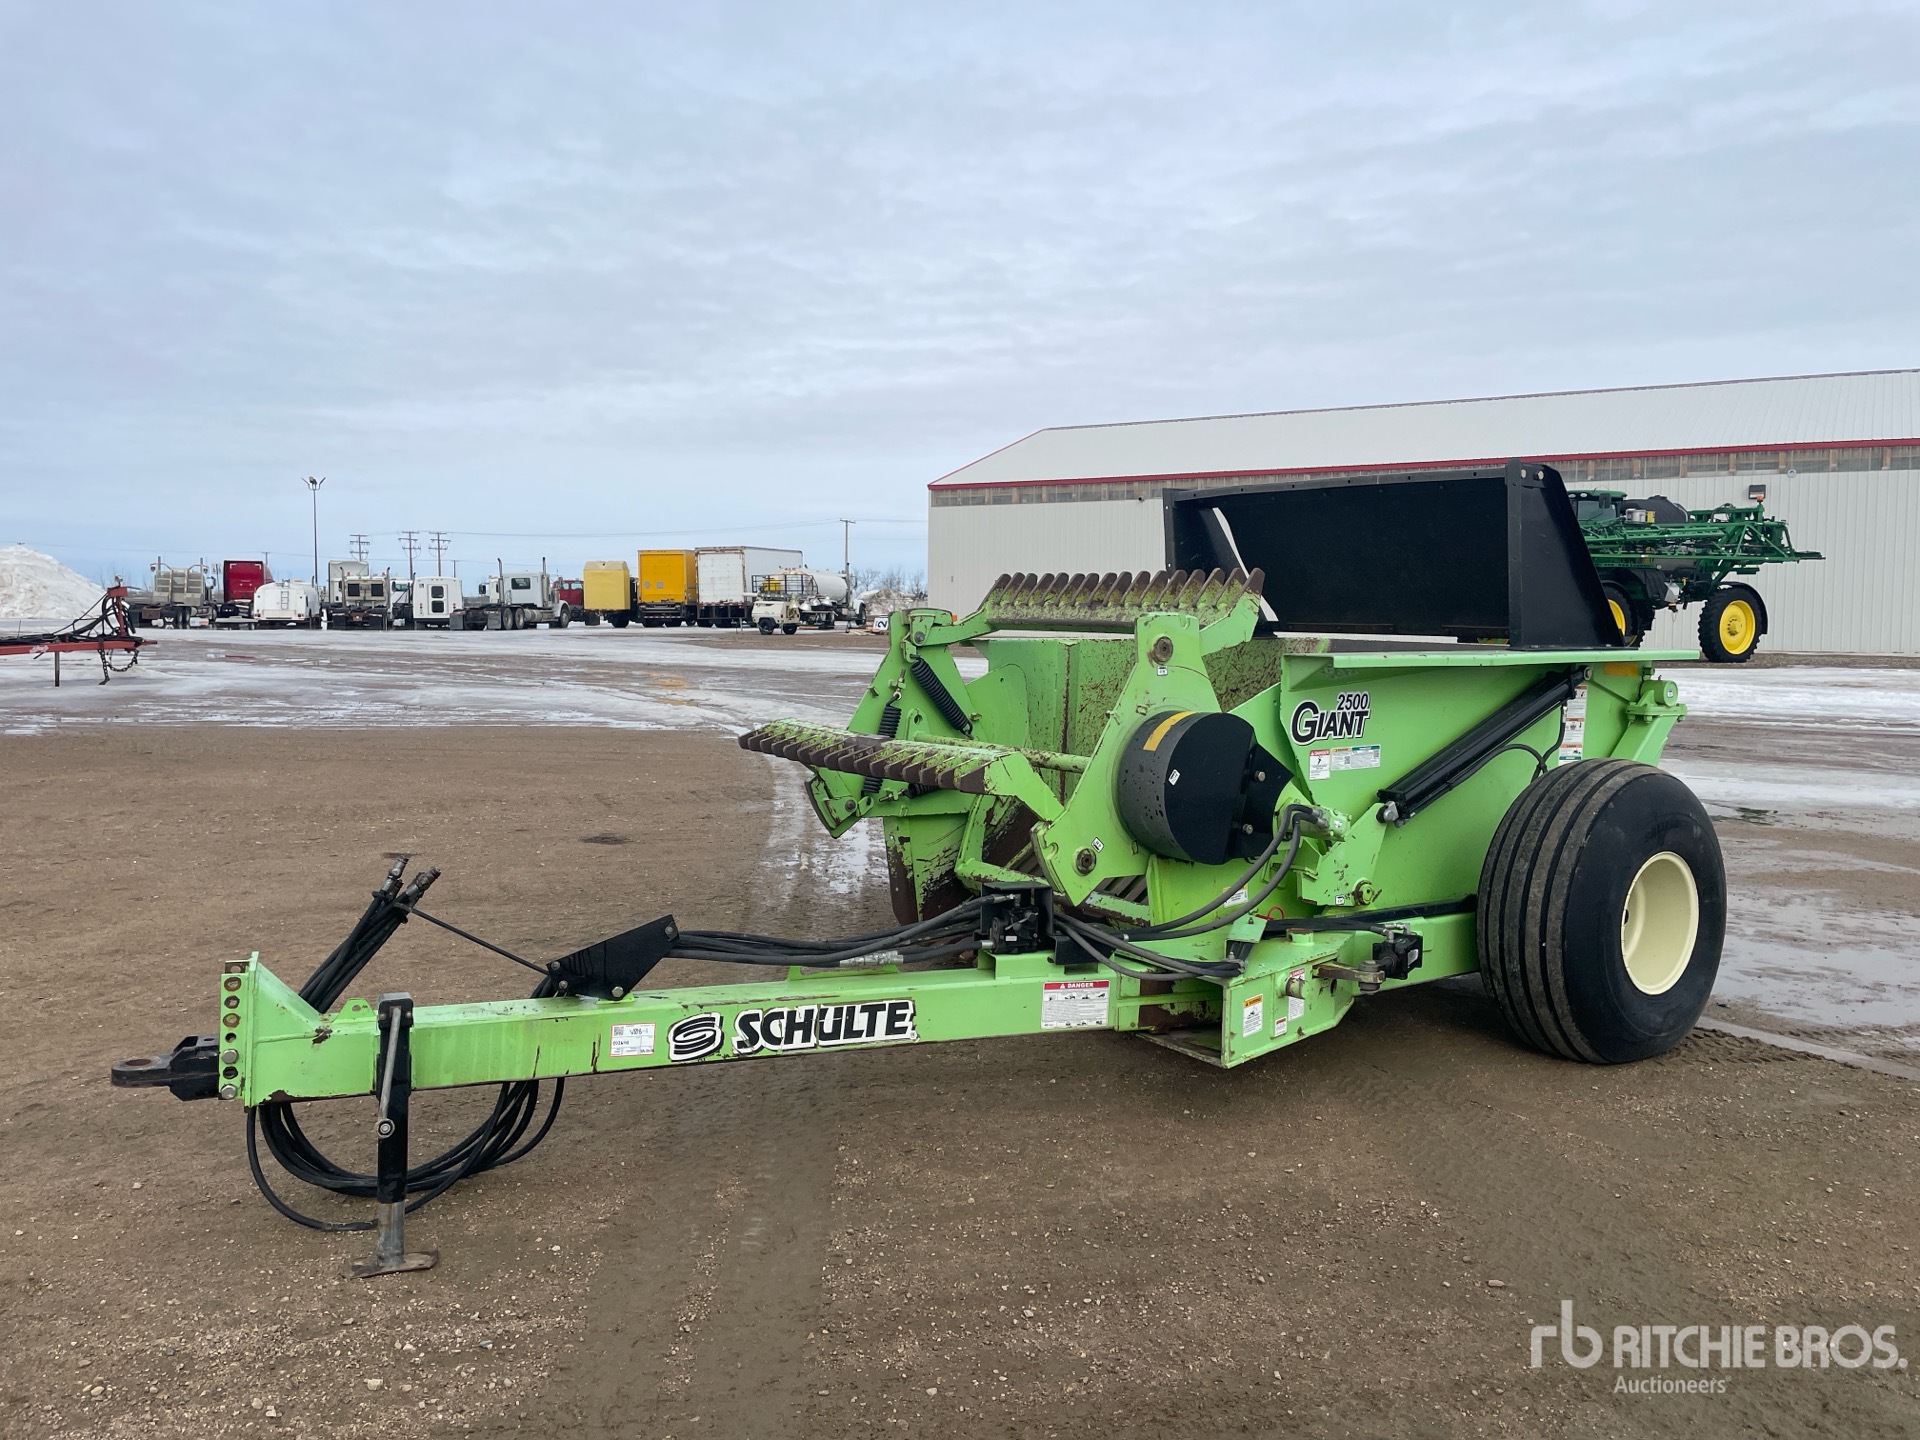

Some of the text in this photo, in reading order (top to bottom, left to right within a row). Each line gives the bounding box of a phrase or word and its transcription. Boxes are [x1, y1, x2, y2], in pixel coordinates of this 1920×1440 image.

[1291, 701, 1369, 743] GIANT
[1337, 693, 1369, 711] 2500
[736, 1001, 914, 1053] SCHULTE
